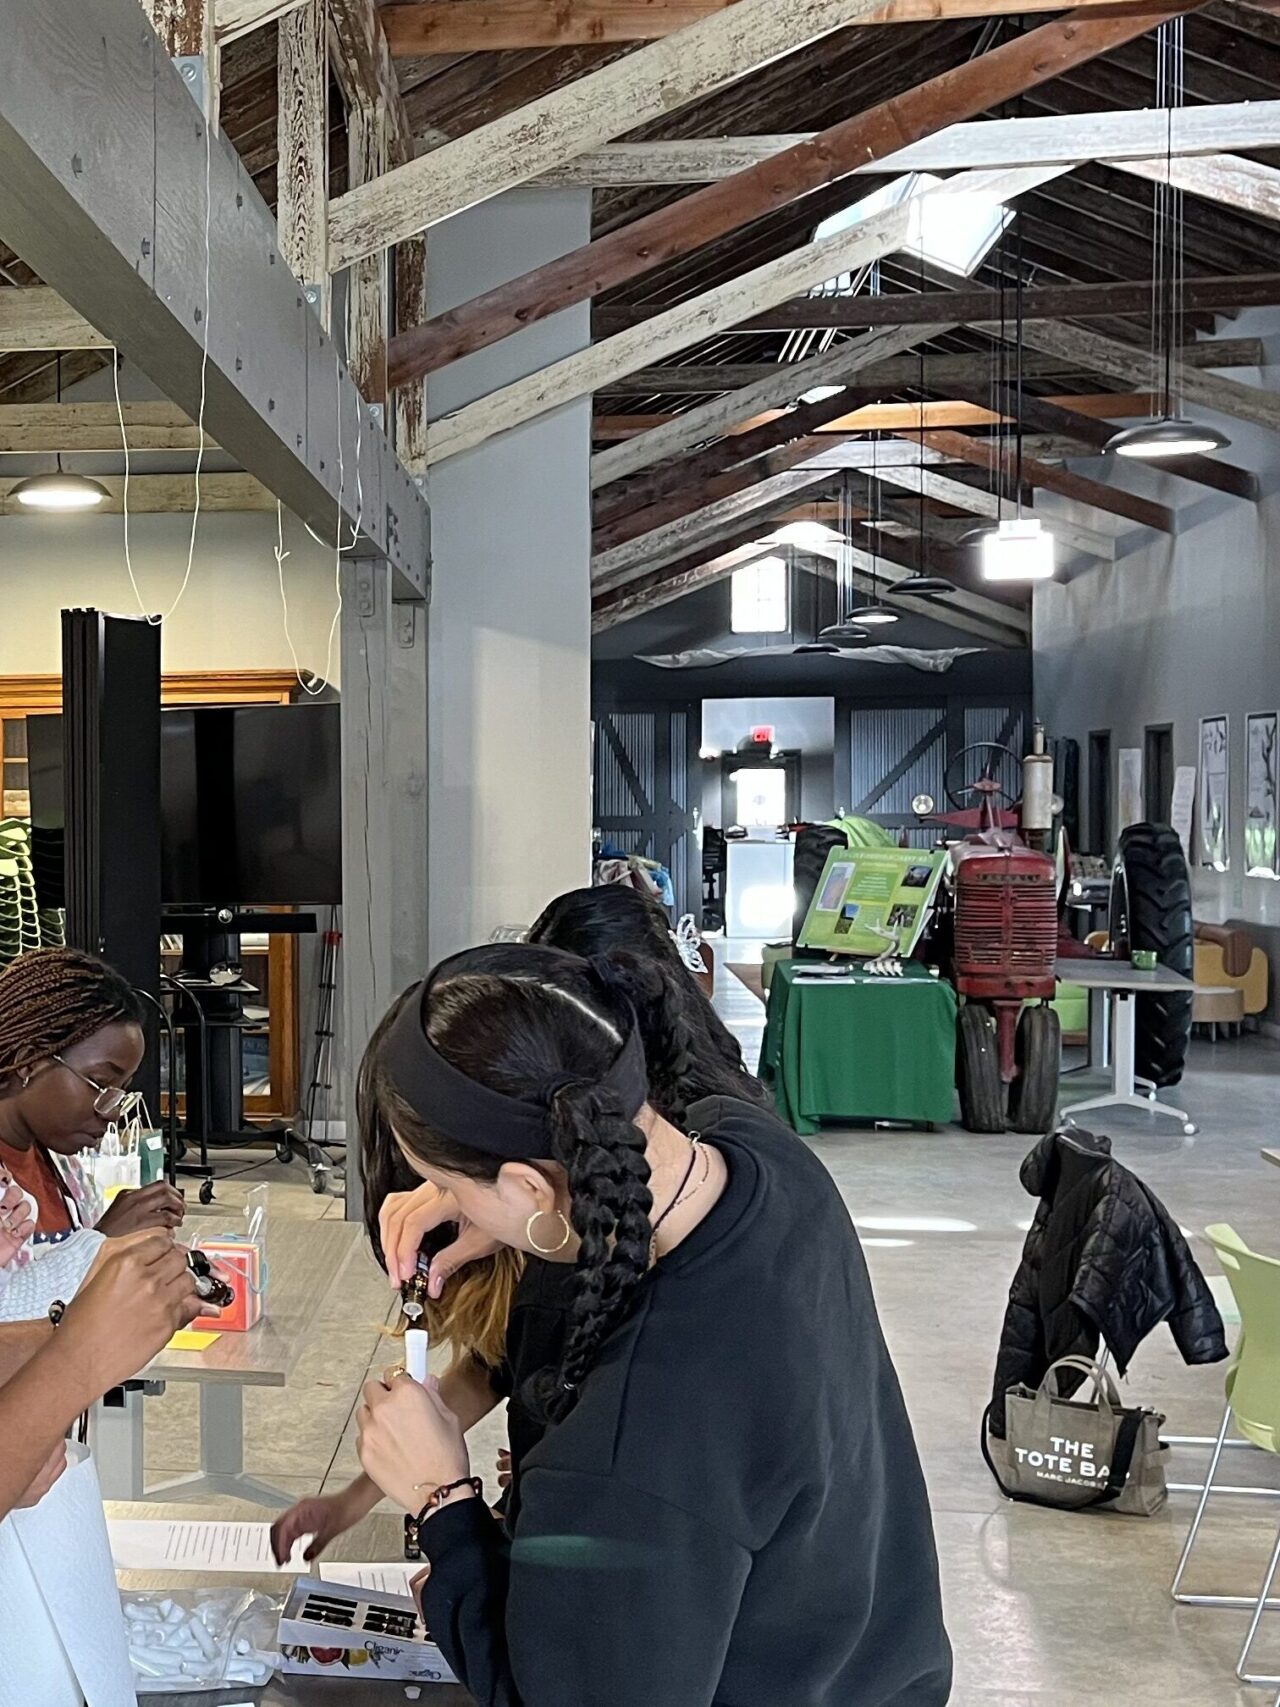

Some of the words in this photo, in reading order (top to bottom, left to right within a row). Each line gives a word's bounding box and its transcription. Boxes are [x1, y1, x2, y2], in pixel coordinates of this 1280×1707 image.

[1049, 1436, 1094, 1459] THE
[1014, 1447, 1072, 1473] TOTE
[1079, 1461, 1130, 1479] BA
[1036, 1471, 1064, 1482] MARC
